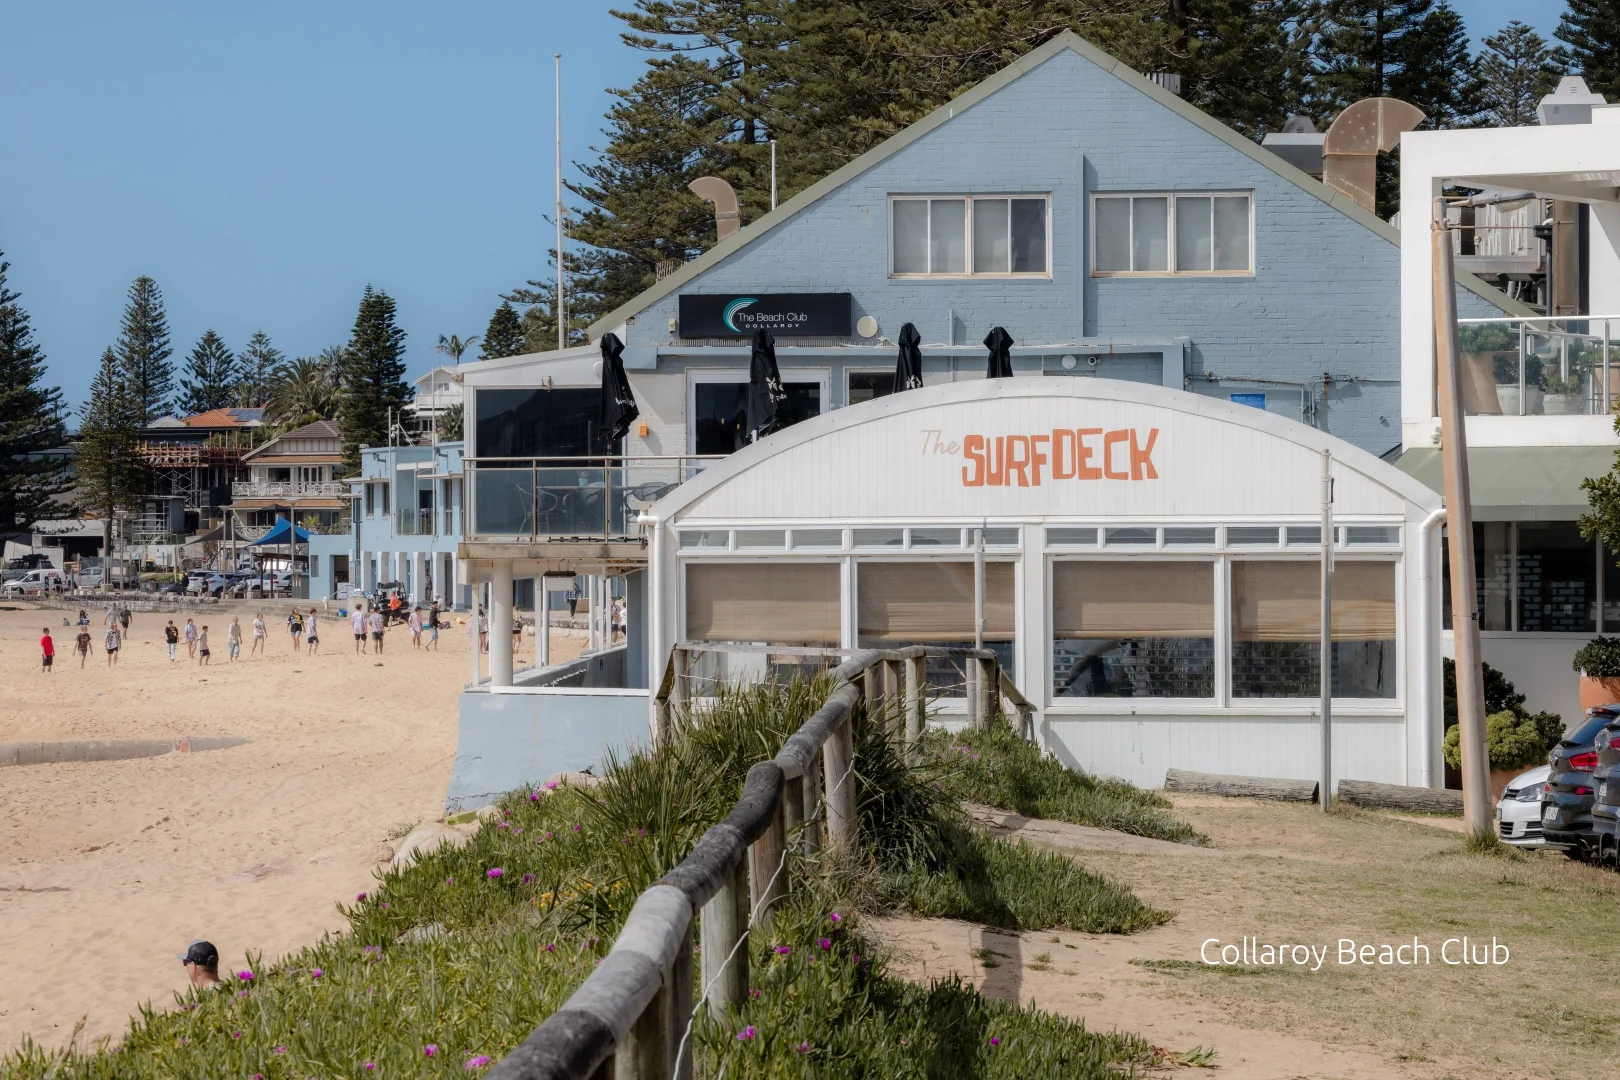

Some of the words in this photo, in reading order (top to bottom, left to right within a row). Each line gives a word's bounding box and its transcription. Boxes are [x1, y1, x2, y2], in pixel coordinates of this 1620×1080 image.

[738, 312, 755, 322] The
[756, 312, 785, 322] Beach
[786, 312, 808, 322] Club
[921, 429, 960, 455] The
